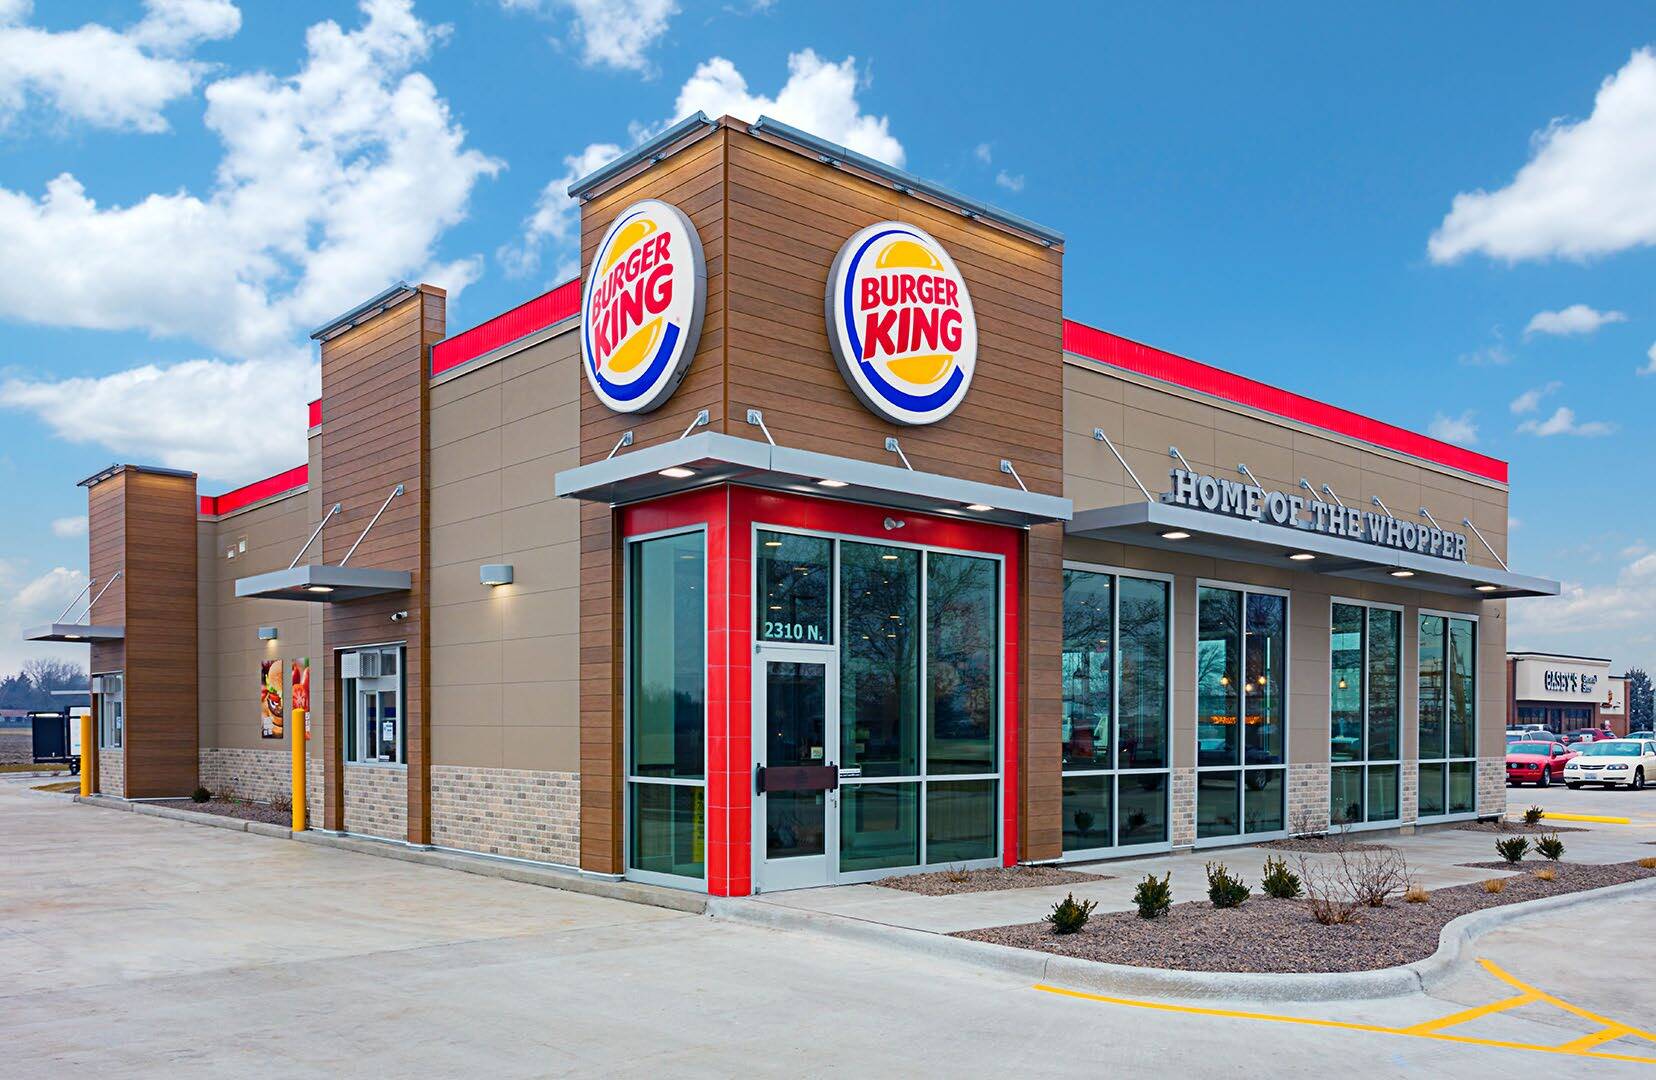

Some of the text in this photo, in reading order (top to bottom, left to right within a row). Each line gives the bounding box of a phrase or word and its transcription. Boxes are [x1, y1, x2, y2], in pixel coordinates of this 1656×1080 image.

[592, 231, 671, 326] BURGER
[861, 273, 959, 311] BURGER
[594, 263, 674, 372] KING
[863, 307, 963, 360] KING
[1172, 468, 1467, 561] HOME OF THE WHOPPER
[764, 621, 823, 641] 2310 N.
